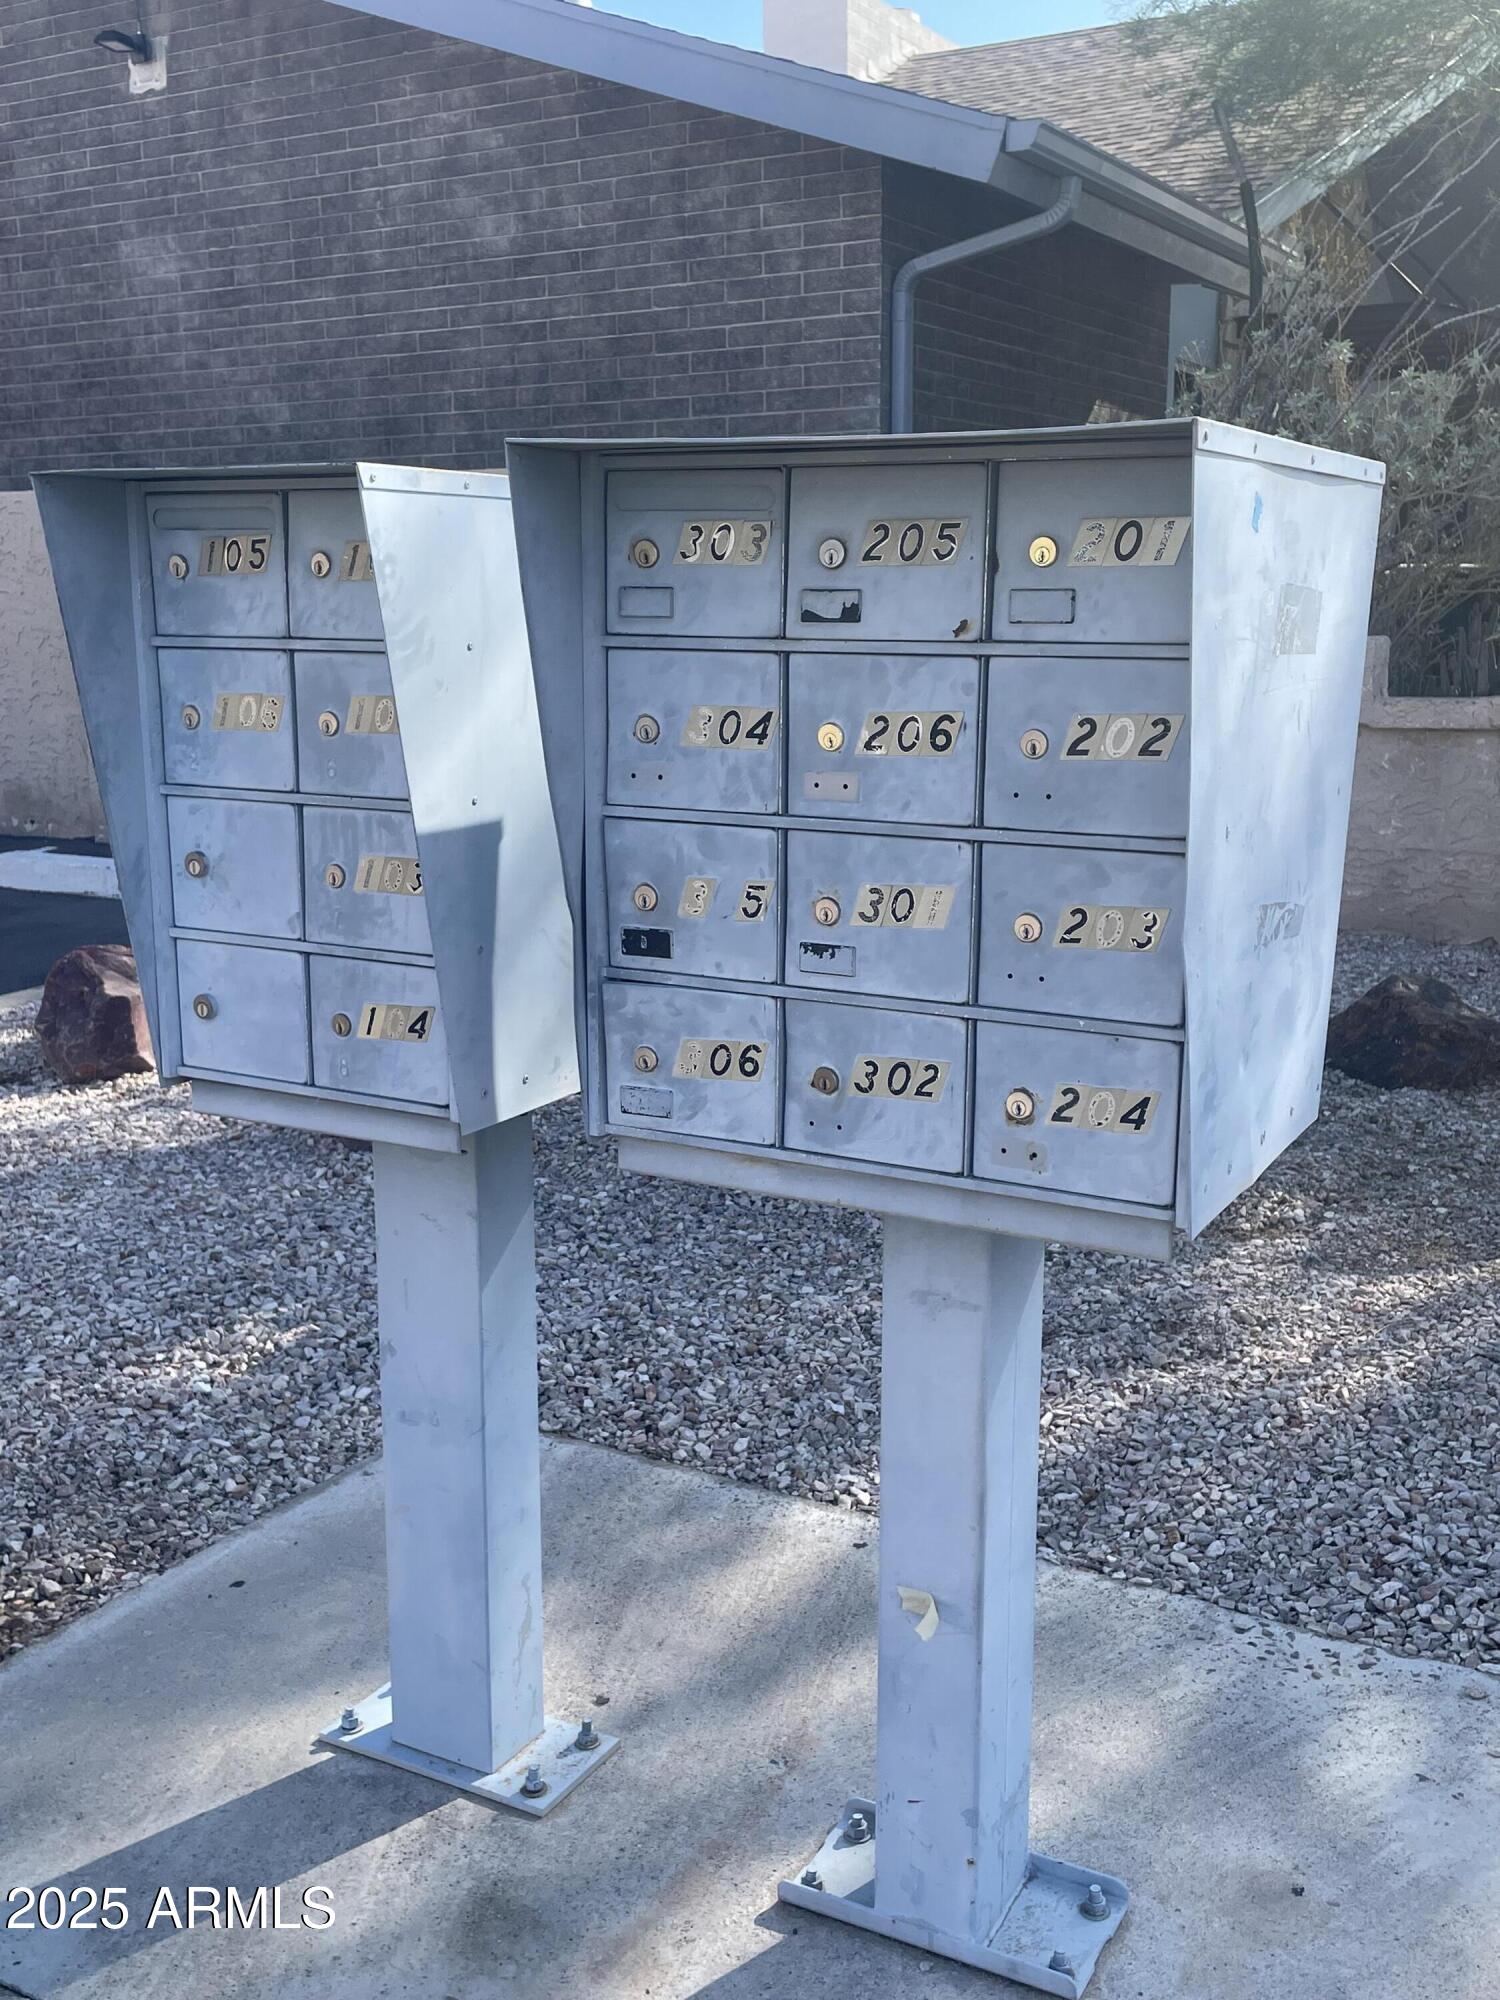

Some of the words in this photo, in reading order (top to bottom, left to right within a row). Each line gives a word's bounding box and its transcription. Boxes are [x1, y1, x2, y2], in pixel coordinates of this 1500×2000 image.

[207, 538, 267, 573] 105
[679, 523, 767, 562] 303
[860, 521, 963, 561] 205
[1074, 519, 1176, 562] 201
[861, 713, 958, 753] 206
[1066, 716, 1173, 758] 202
[1058, 907, 1161, 950] 203
[853, 1059, 941, 1099] 302
[1051, 1087, 1154, 1131] 204
